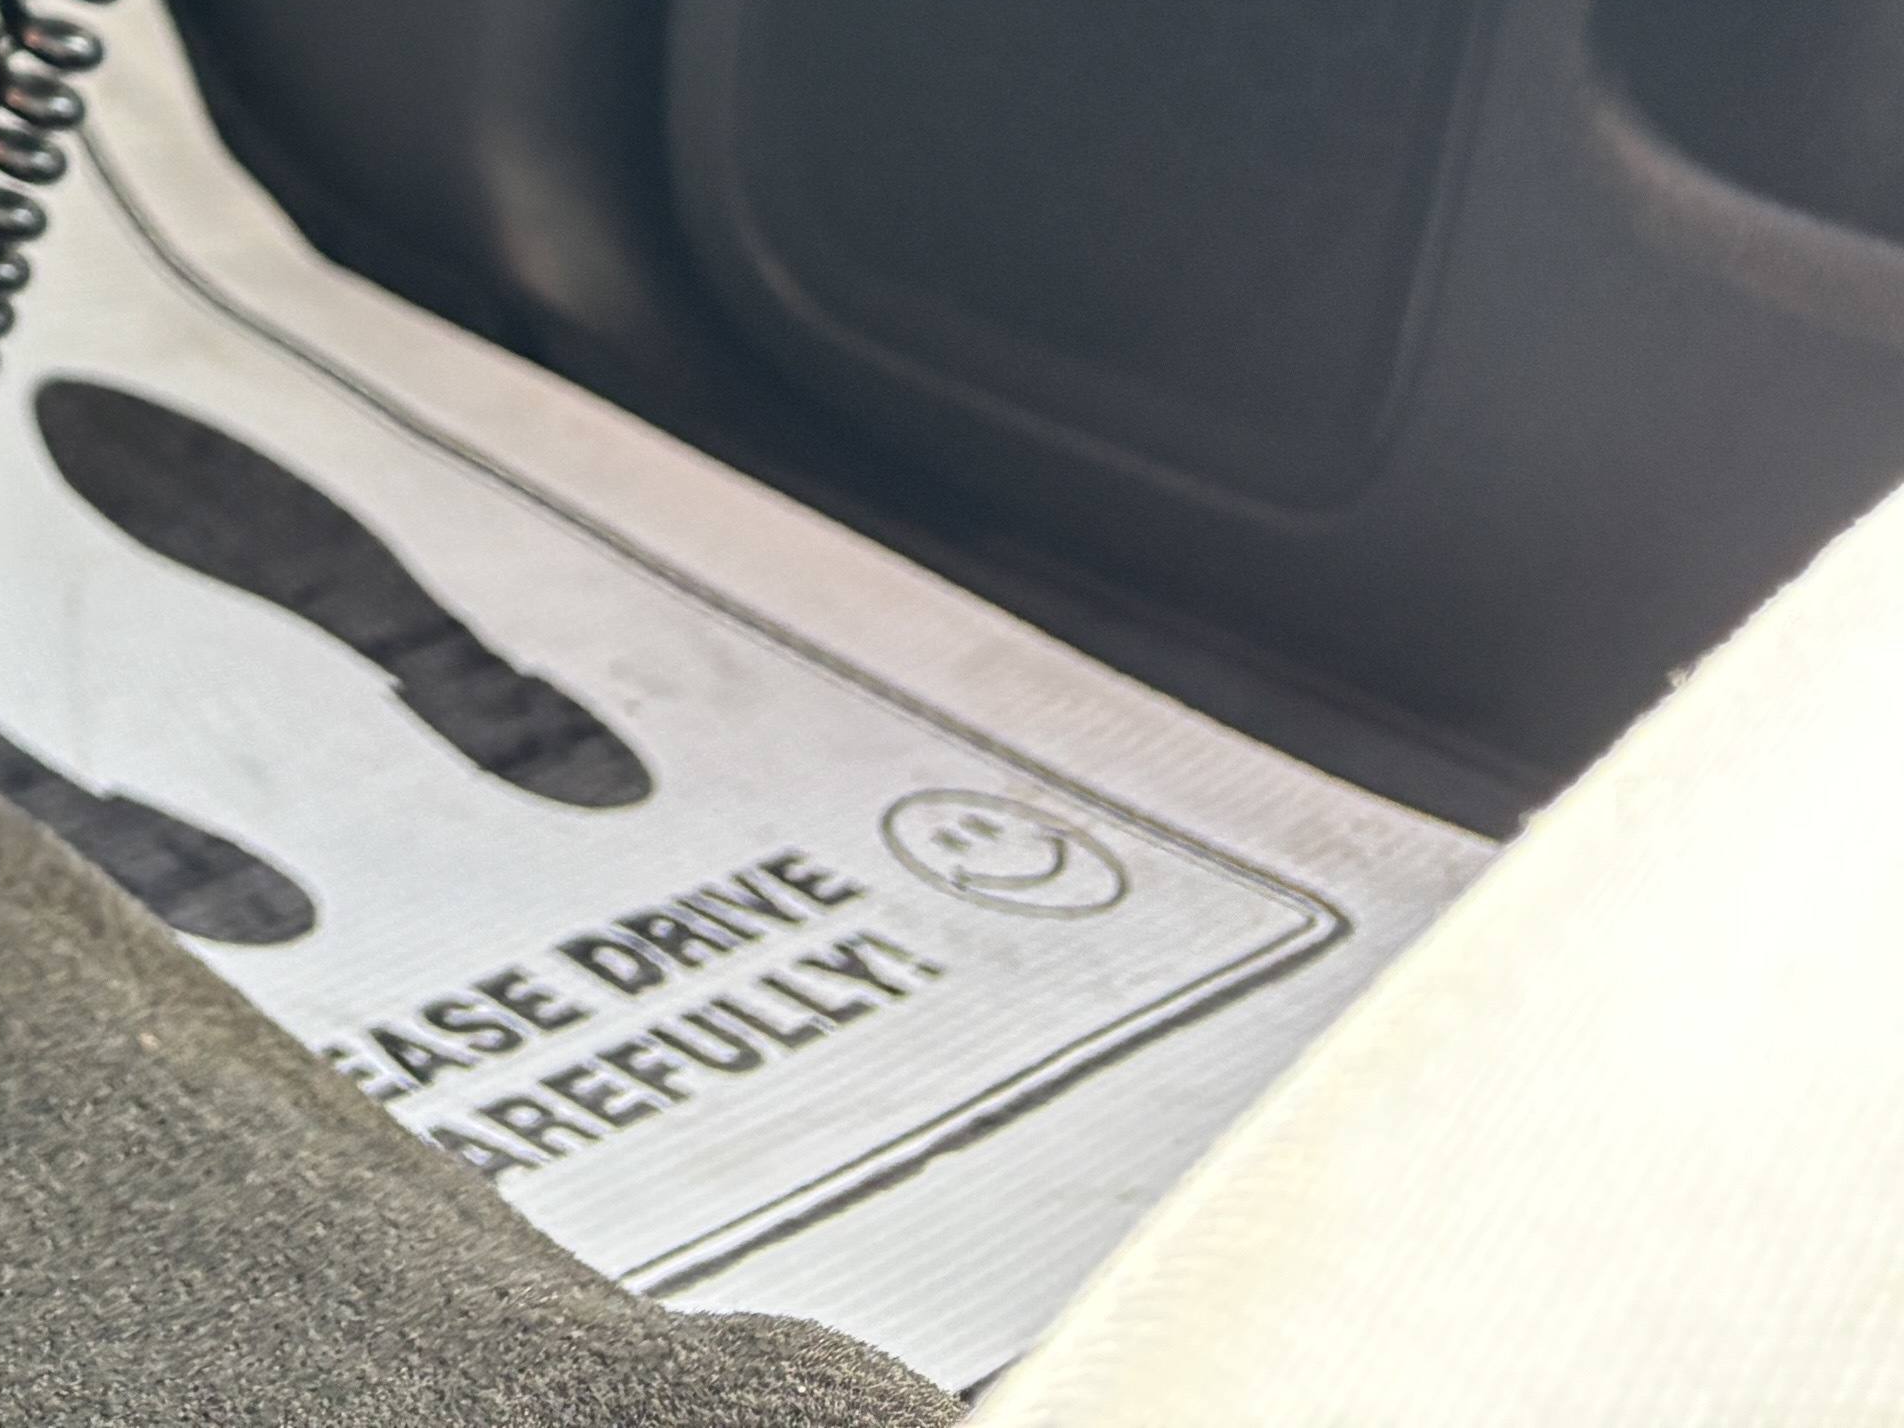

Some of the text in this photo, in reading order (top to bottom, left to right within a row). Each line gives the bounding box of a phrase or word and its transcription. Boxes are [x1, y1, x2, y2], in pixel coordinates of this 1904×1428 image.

[319, 847, 866, 1098] EASE DRIVE
[428, 929, 946, 1178] AREFULLY!
